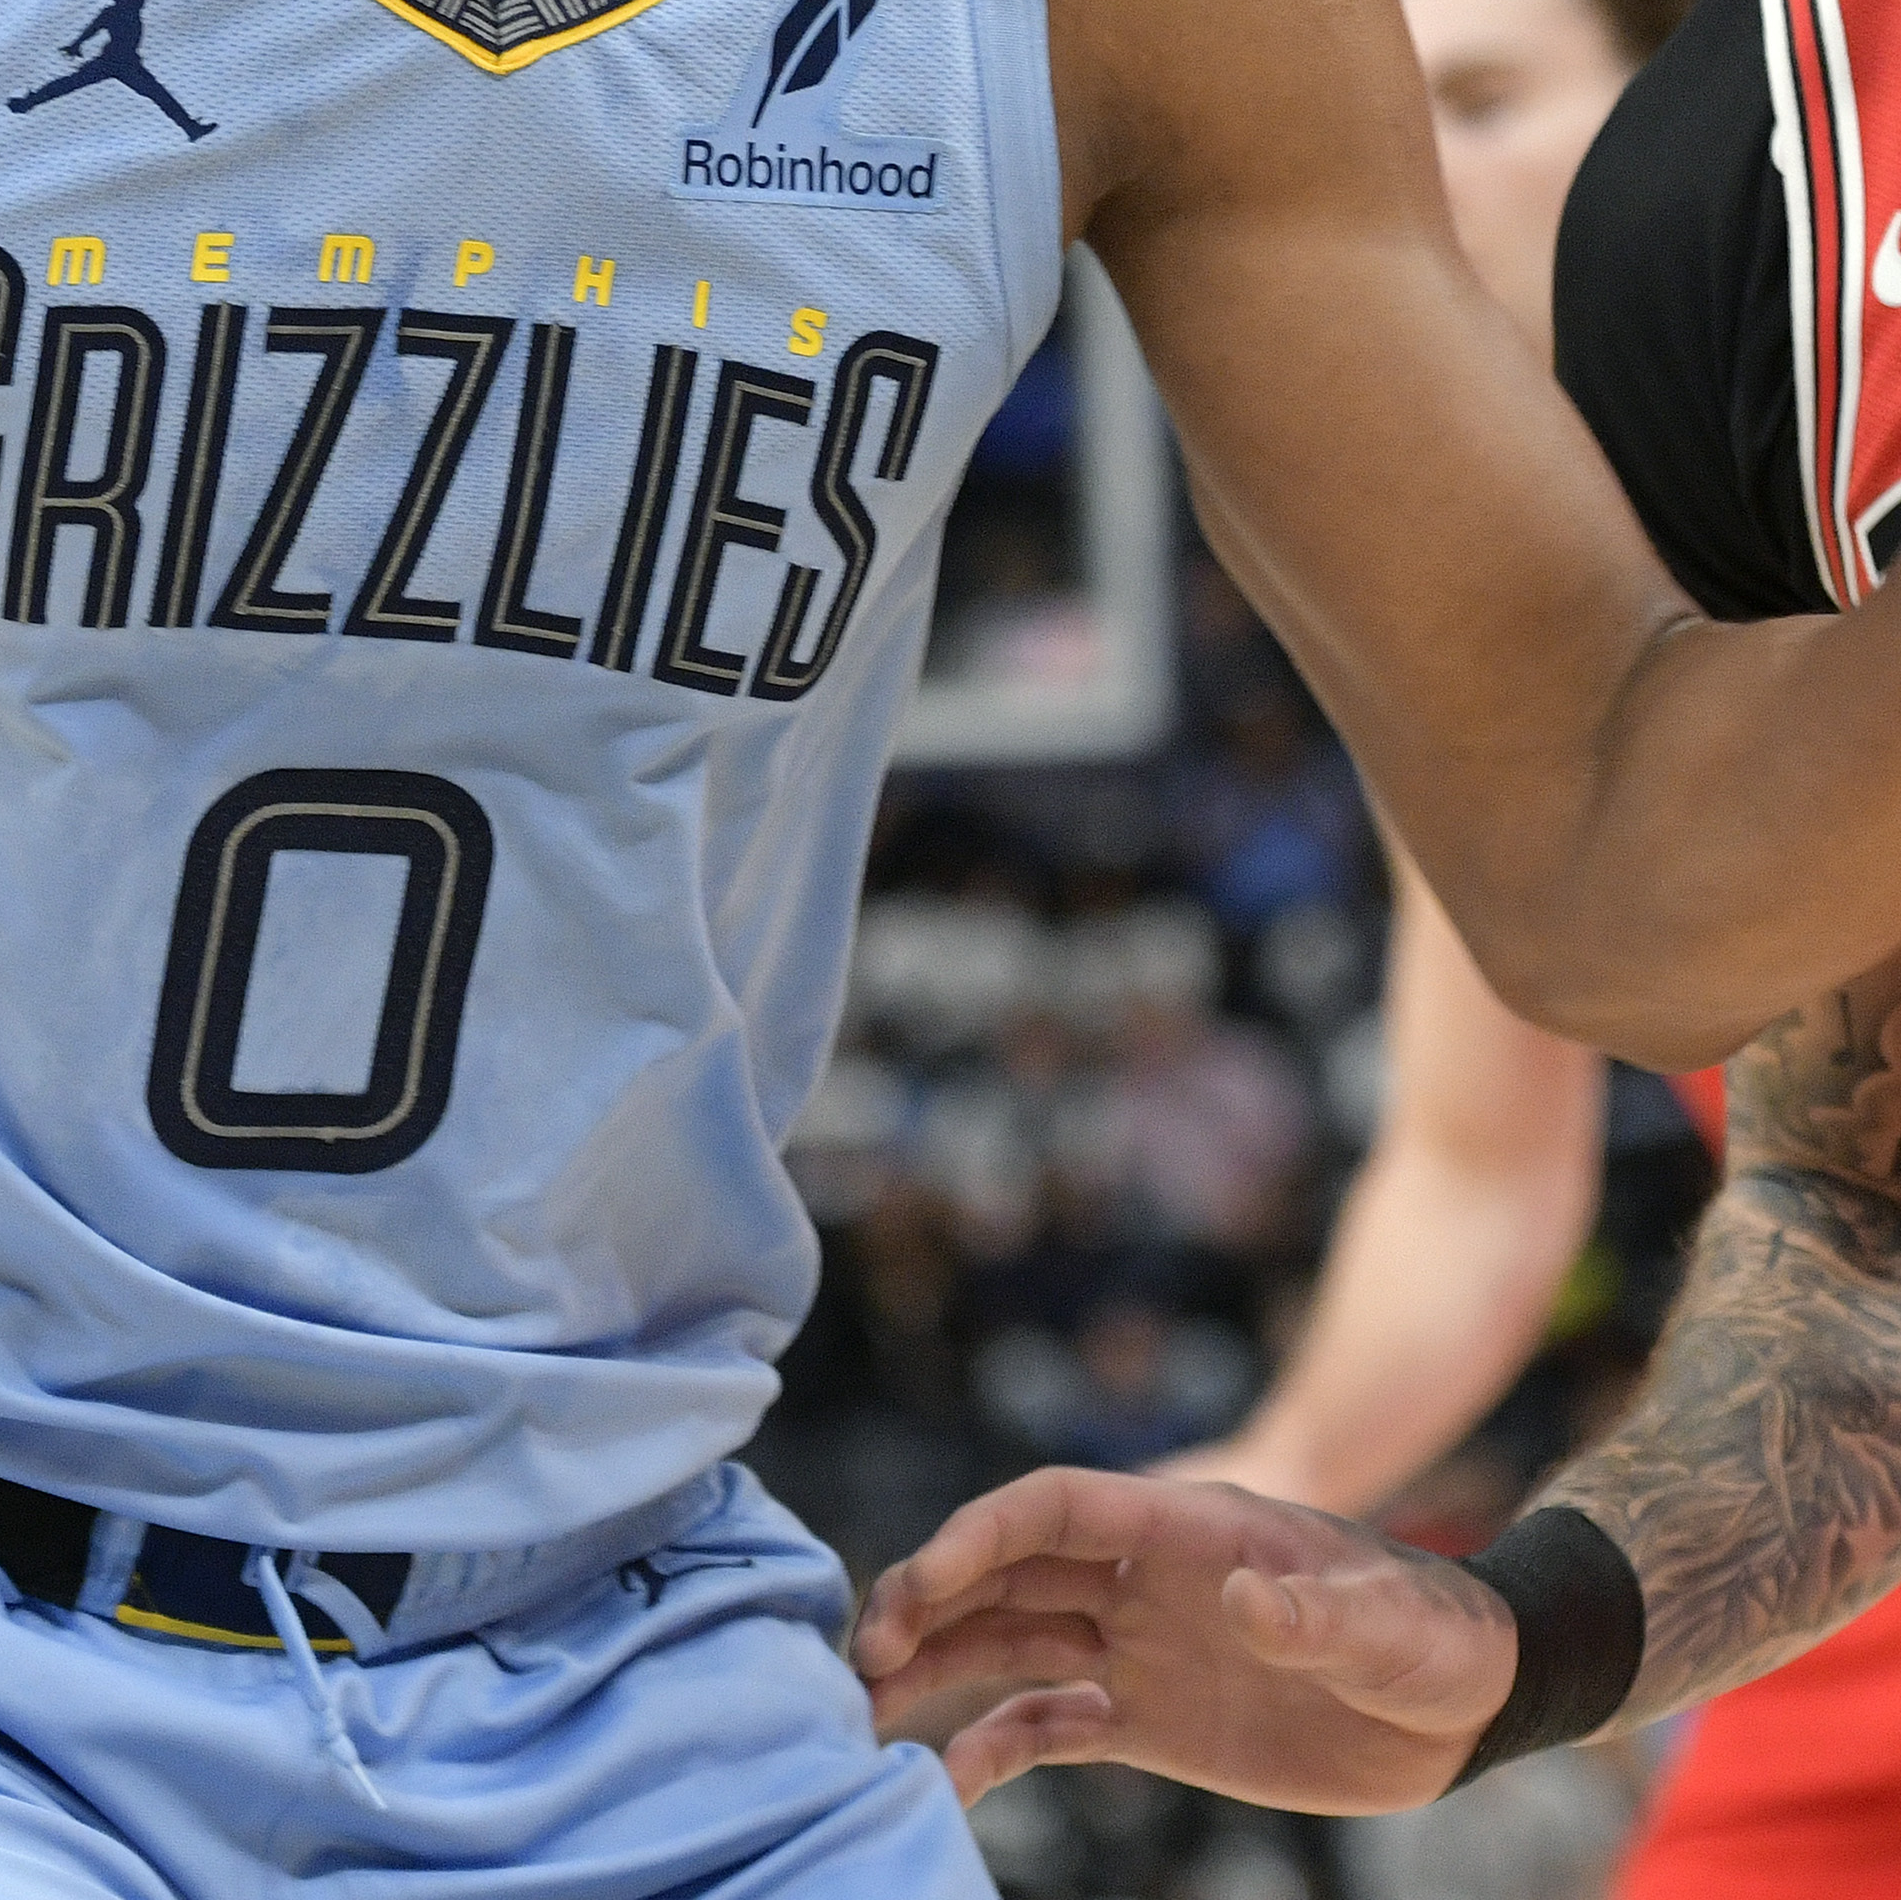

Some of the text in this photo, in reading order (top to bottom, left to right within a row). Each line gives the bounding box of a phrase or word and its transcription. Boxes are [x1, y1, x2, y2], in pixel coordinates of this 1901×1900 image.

[683, 138, 937, 199] Robinhood
[46, 231, 828, 358] MEMPHIS
[146, 767, 495, 1176] 0
